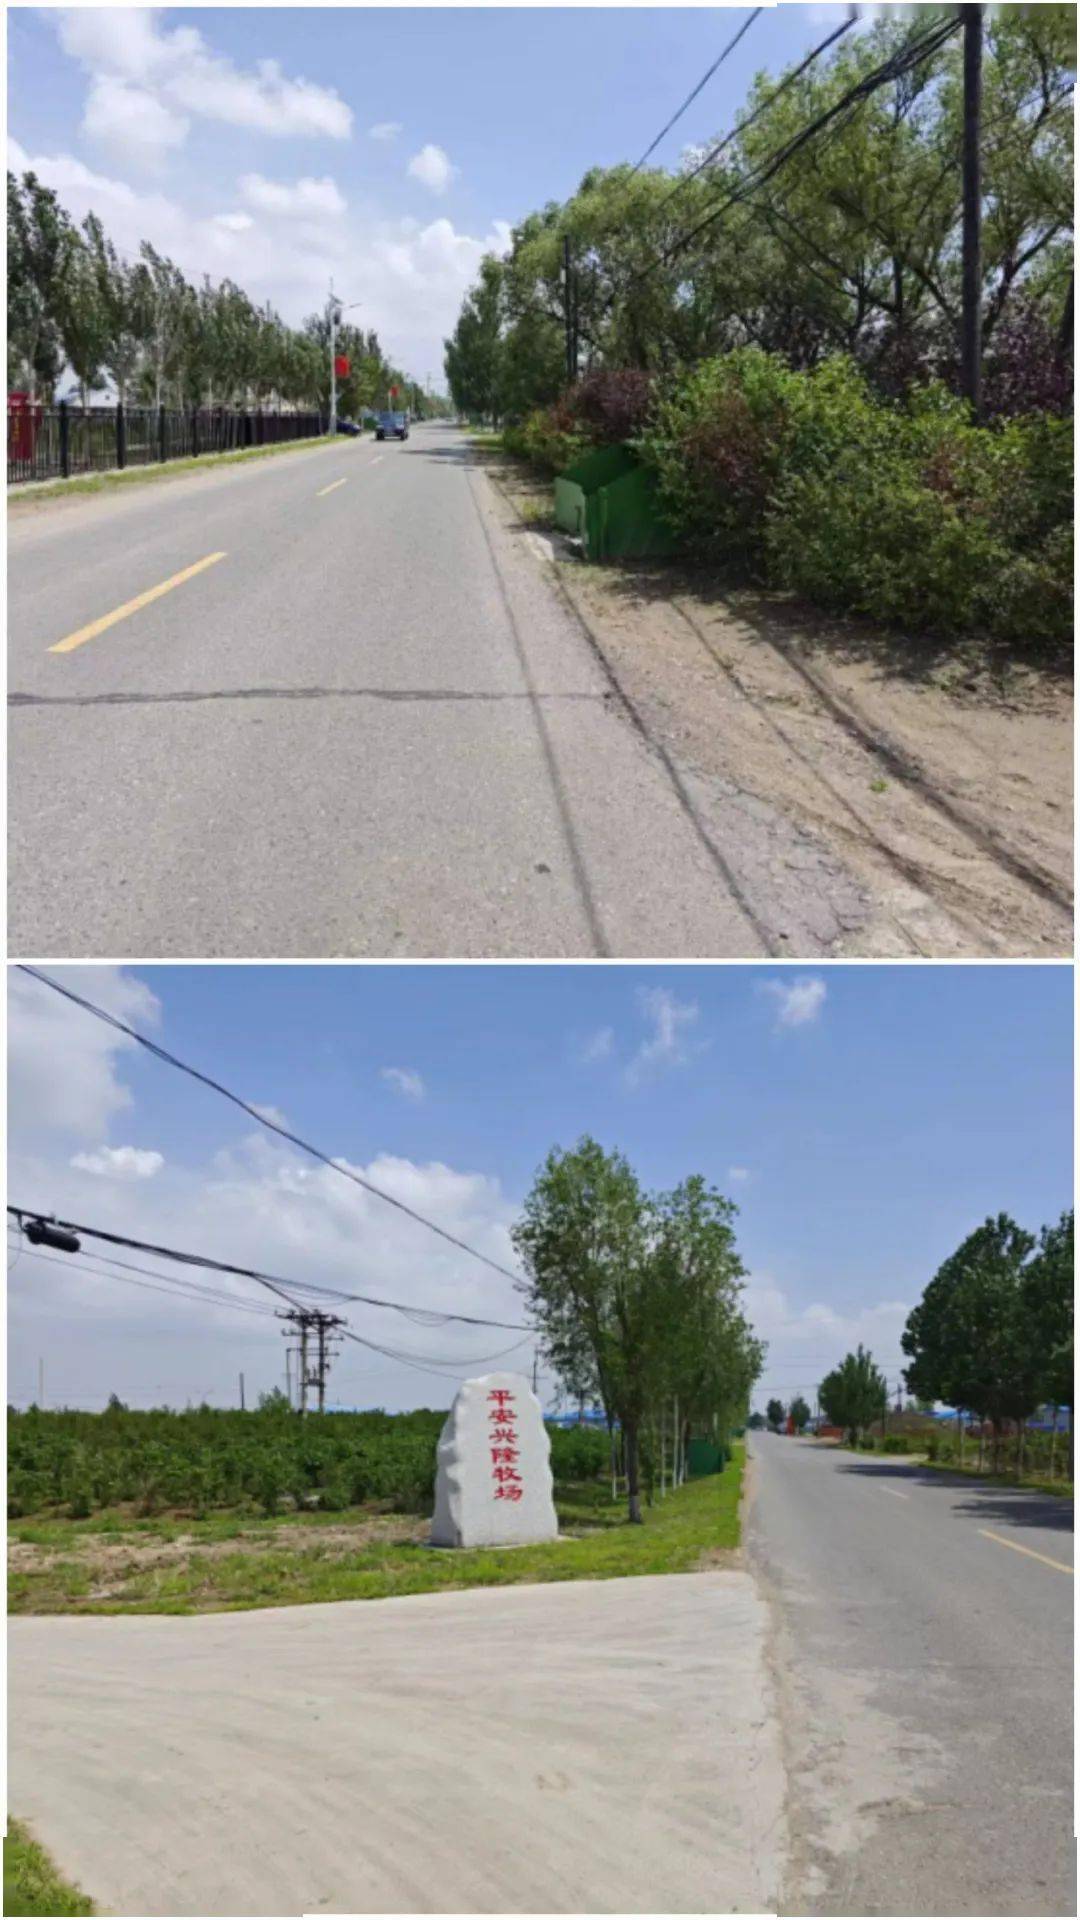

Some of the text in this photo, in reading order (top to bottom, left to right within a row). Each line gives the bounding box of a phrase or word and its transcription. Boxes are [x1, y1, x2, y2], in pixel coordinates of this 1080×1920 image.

[487, 1390, 523, 1501] 平安兴隆牧场
